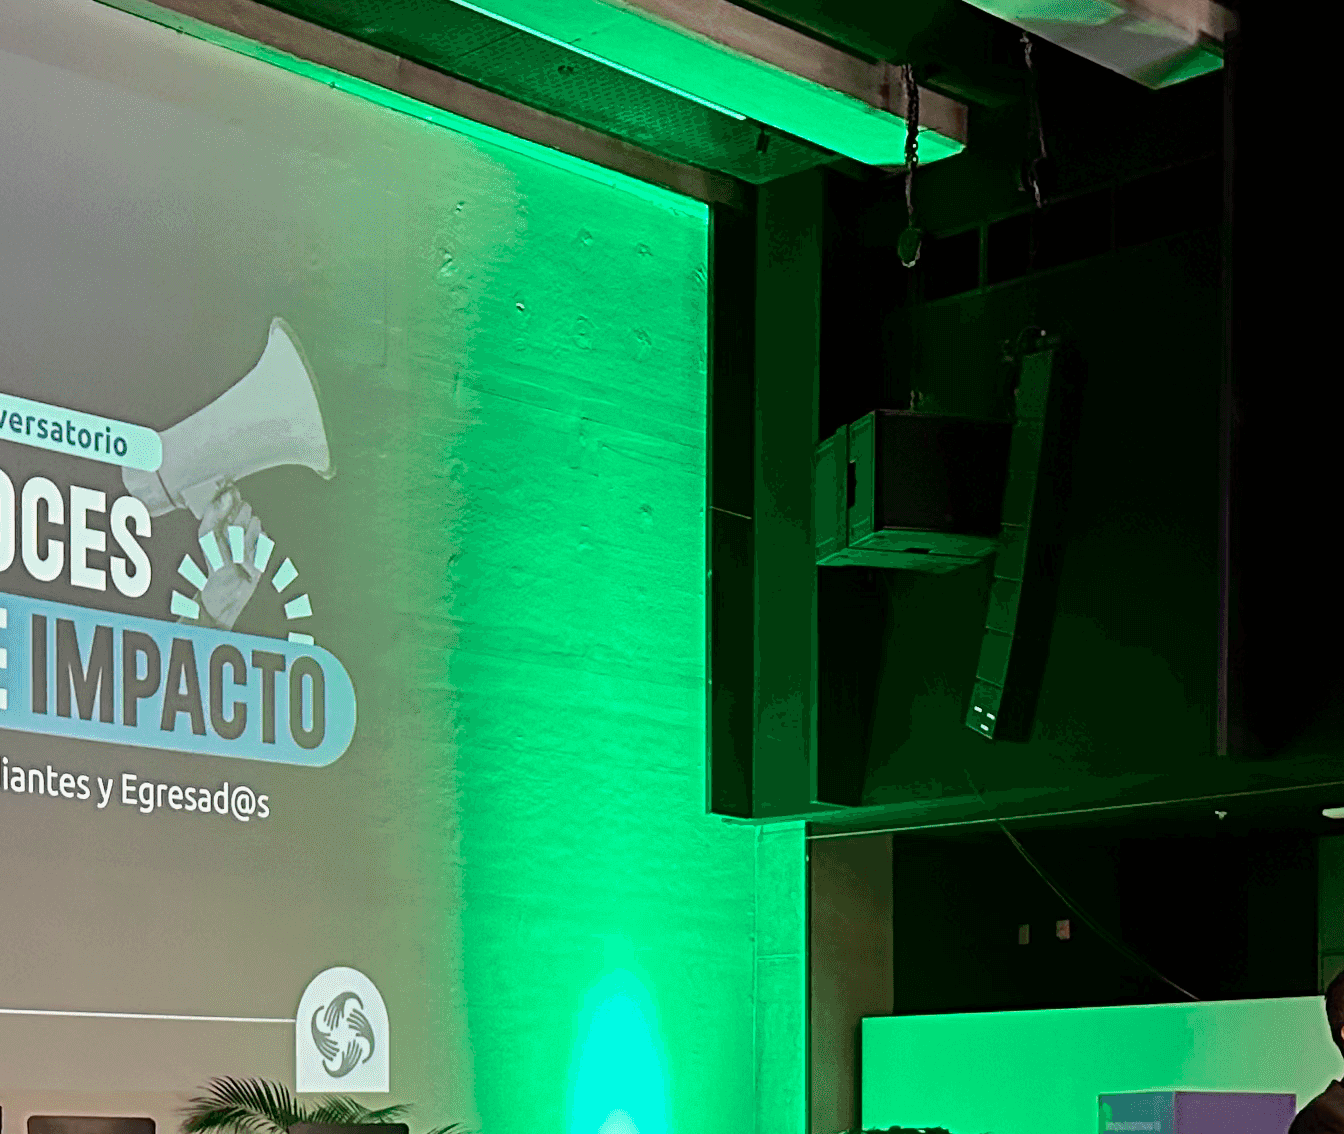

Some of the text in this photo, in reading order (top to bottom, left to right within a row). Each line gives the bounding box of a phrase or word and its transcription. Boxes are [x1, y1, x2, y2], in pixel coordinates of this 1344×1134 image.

[30, 613, 327, 750] IMPACTO
[96, 776, 114, 809] y
[121, 773, 271, 823] Egresad@s
